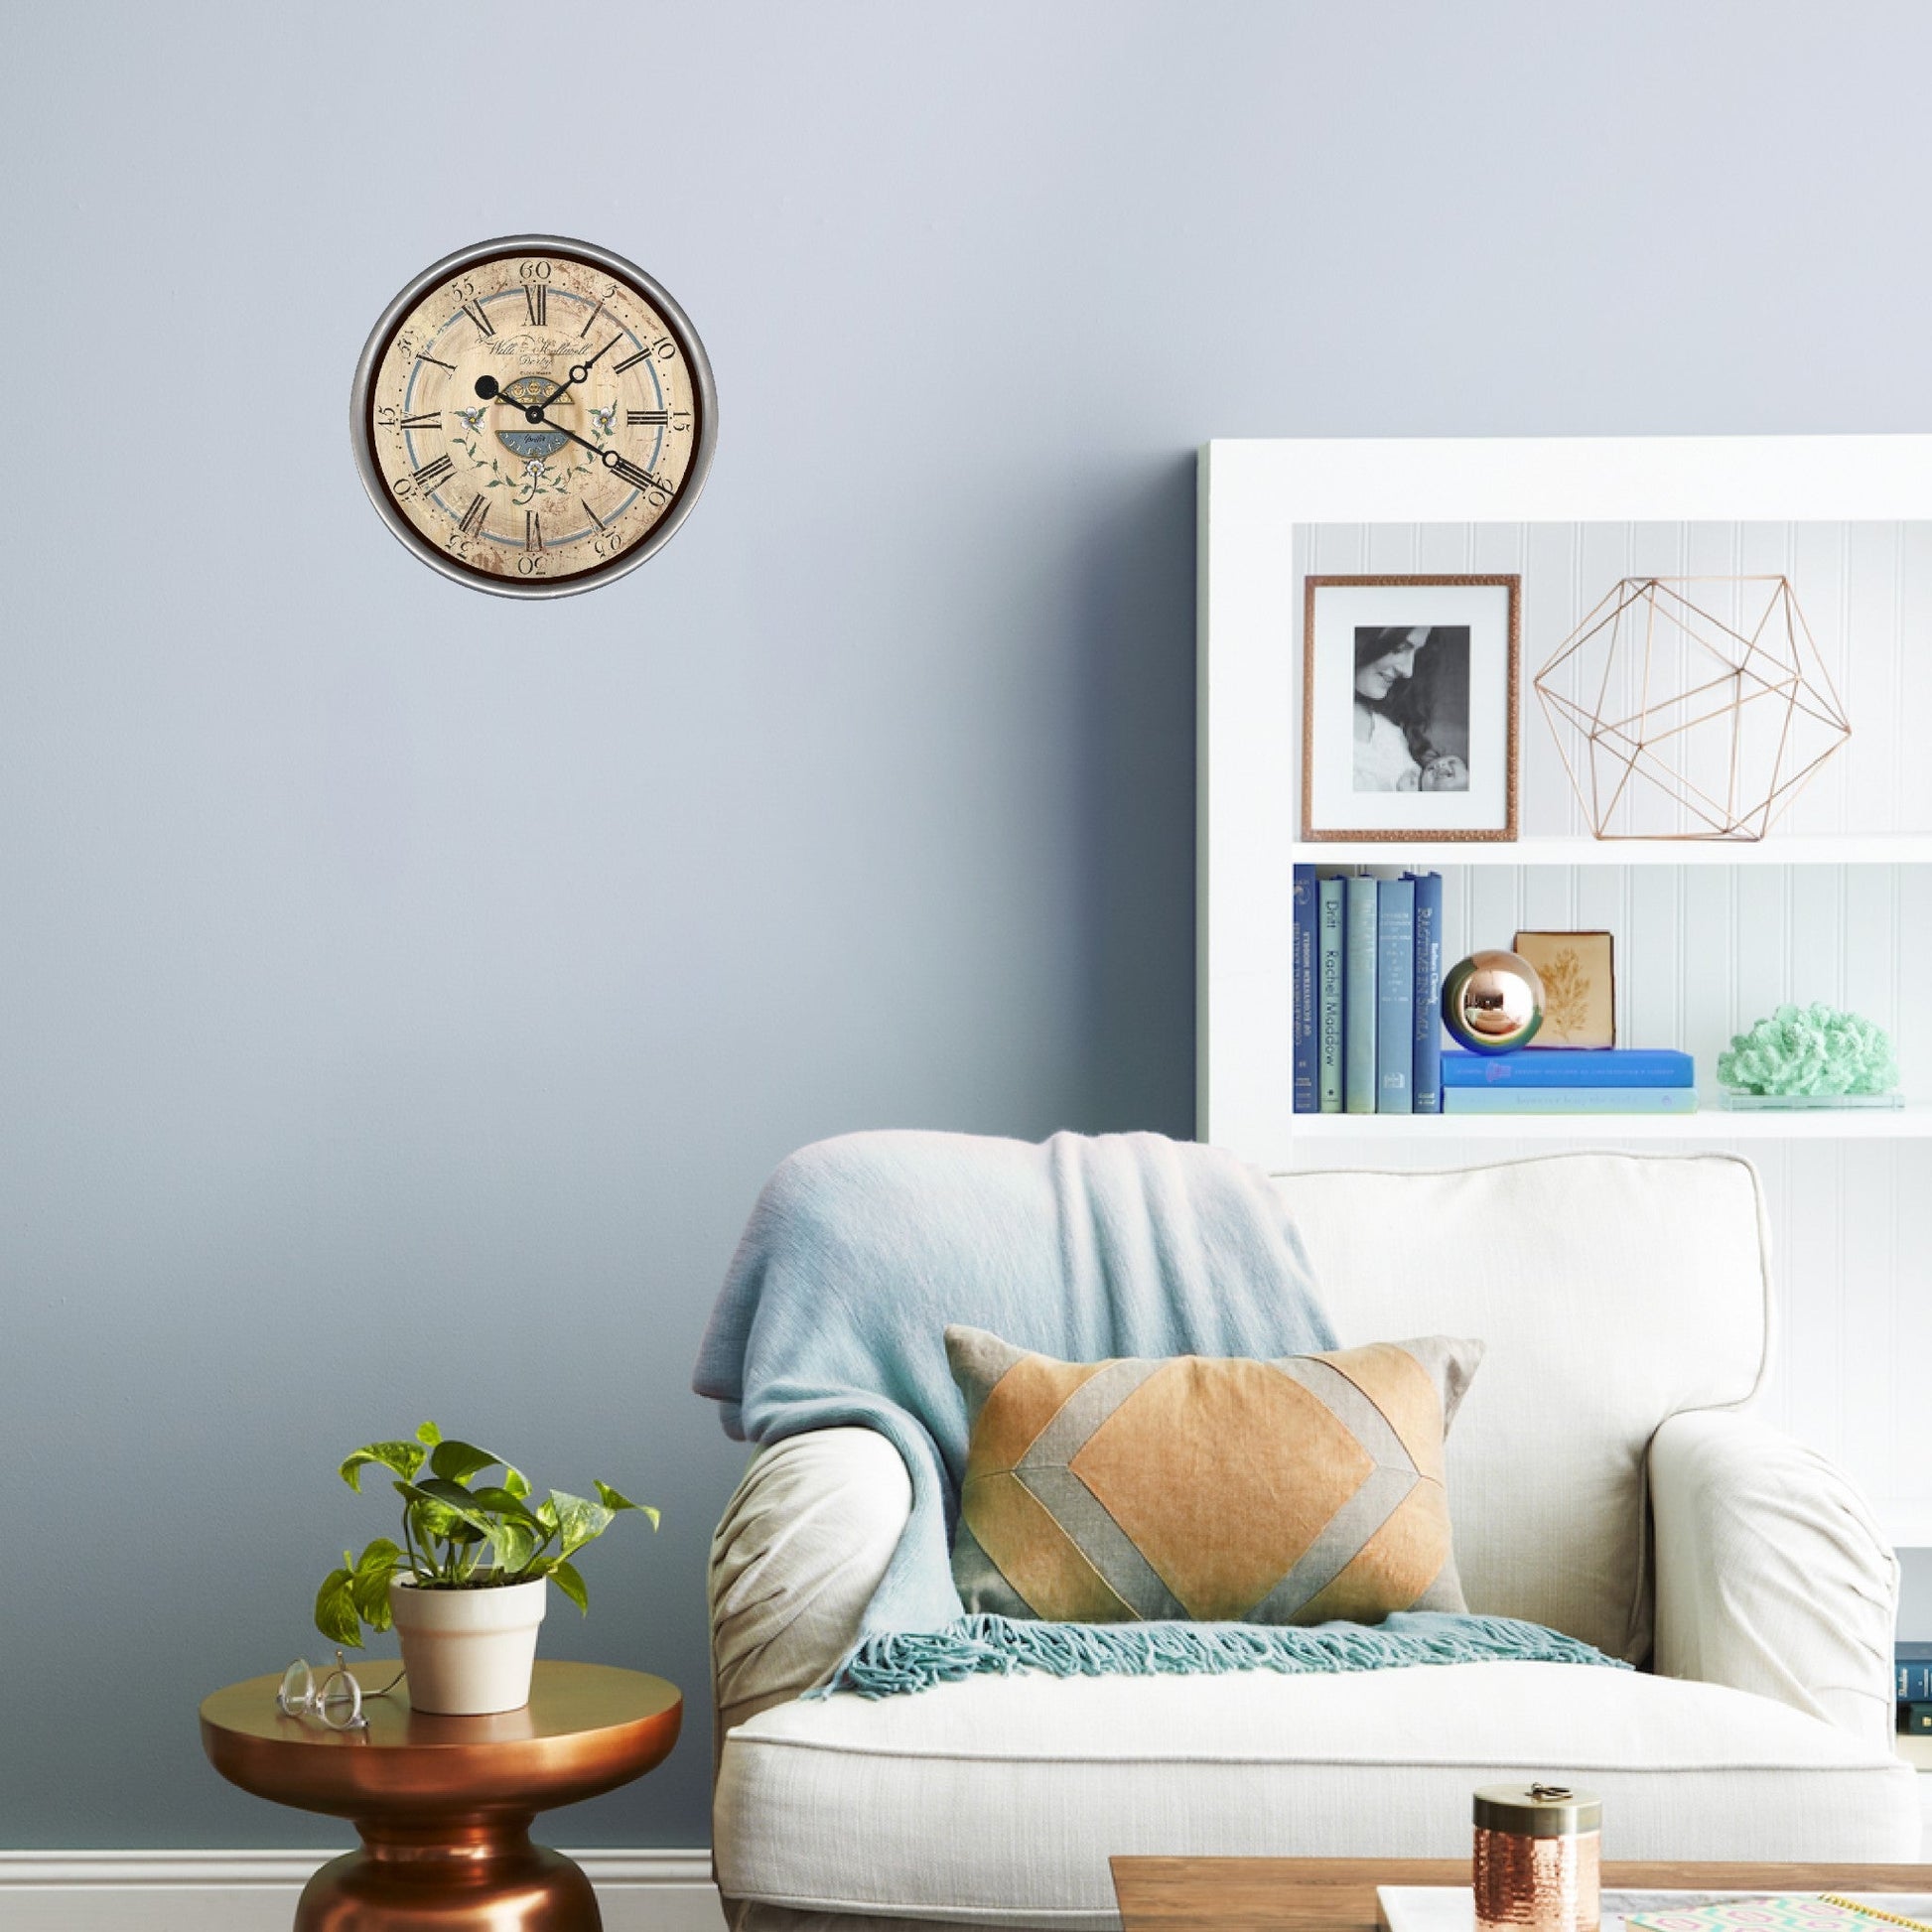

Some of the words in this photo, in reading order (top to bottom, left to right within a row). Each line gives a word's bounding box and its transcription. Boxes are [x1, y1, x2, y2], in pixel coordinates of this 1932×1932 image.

[519, 261, 552, 280] 60
[451, 275, 476, 303] 55
[602, 281, 619, 299] 5
[519, 284, 549, 327] XII
[611, 346, 653, 375] II
[652, 337, 676, 360] 10
[415, 349, 458, 379] X
[378, 405, 396, 434] 45
[626, 408, 669, 428] III
[672, 408, 692, 432] 15
[517, 556, 549, 575] 30
[1325, 899, 1339, 928] Drift
[1325, 950, 1339, 998] Rachel
[1325, 1002, 1339, 1066] Maddow
